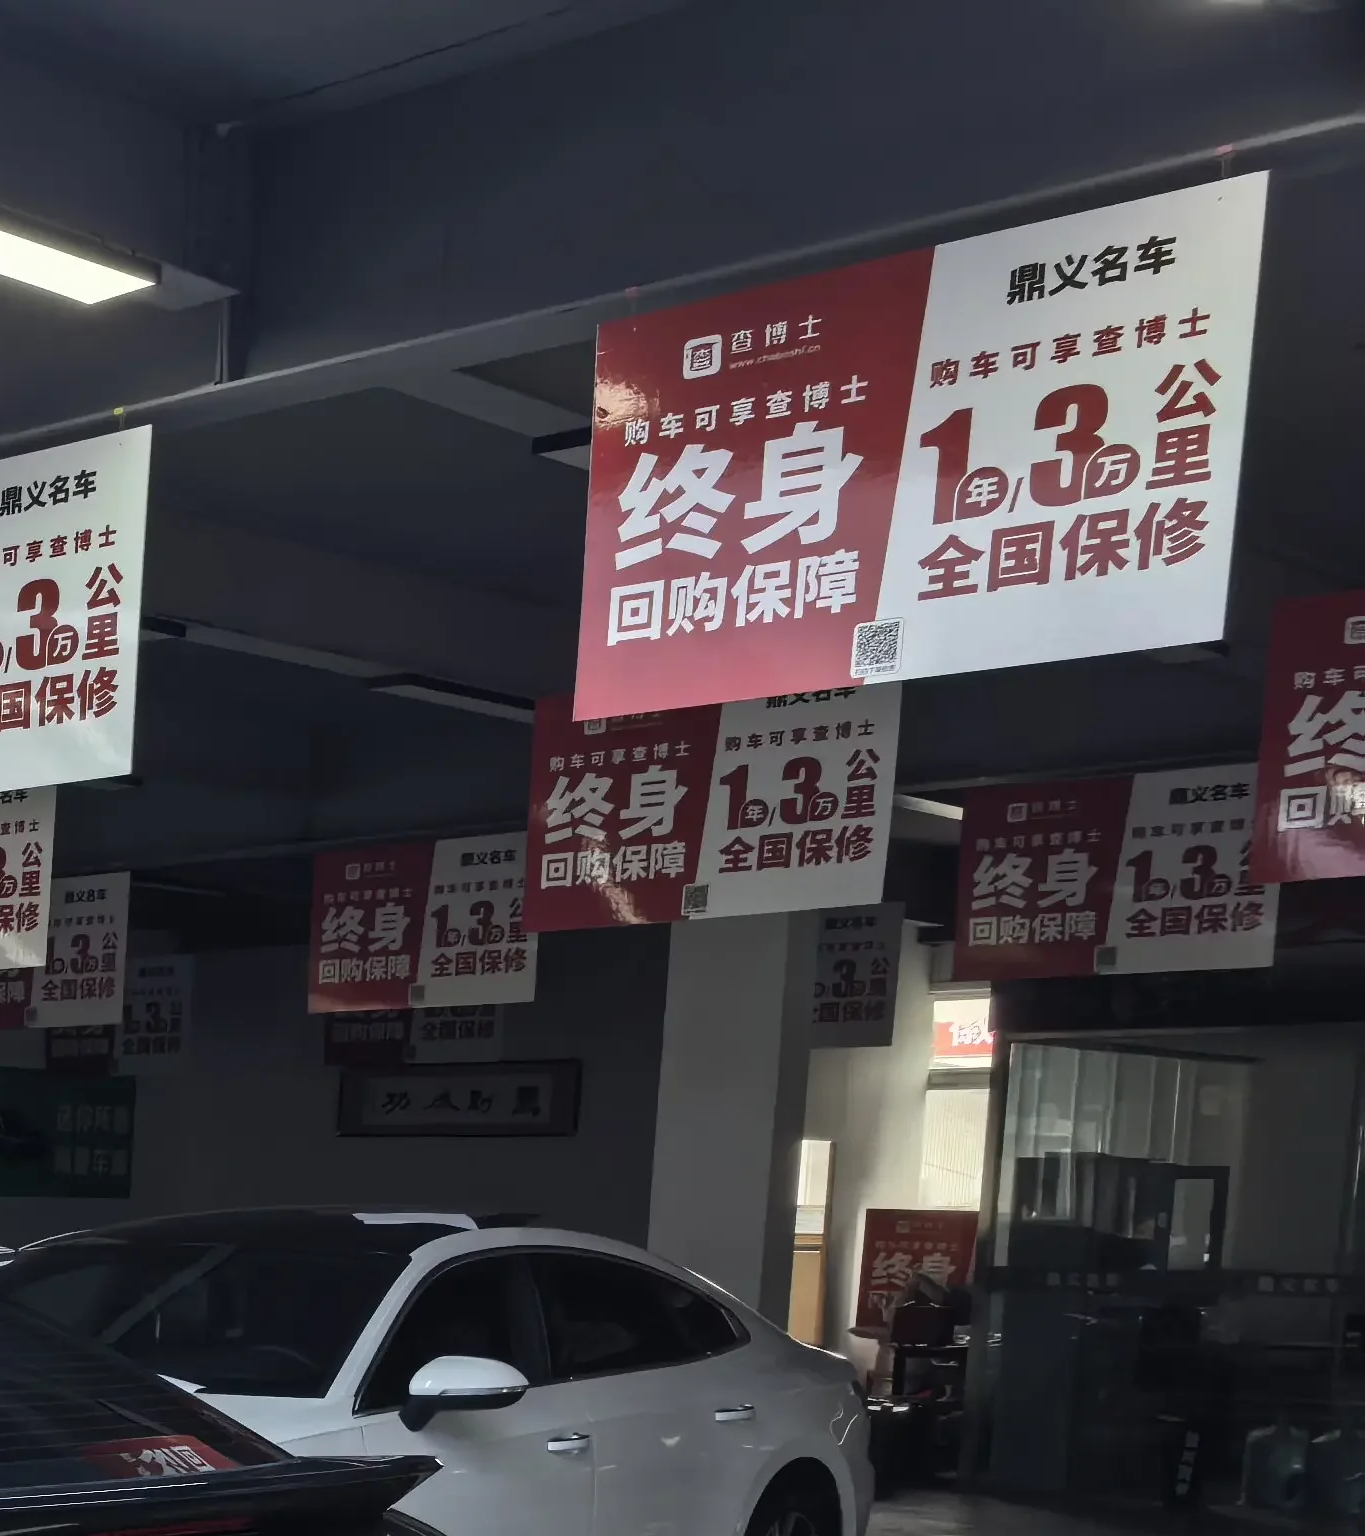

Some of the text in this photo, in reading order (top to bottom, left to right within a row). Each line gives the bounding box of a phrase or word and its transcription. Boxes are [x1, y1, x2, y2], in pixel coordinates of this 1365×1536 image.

[1006, 235, 1176, 305] 鼎义名车
[730, 315, 822, 355] 查博士
[930, 307, 1210, 388] 购车可享查博士
[624, 374, 869, 447] 购车可享查博士
[0, 469, 97, 517] 鼎义名车
[615, 420, 865, 571] 终身
[916, 498, 1210, 601] 全国保修
[606, 549, 860, 647] 回购保障
[549, 741, 691, 773] 购车可享查博士
[724, 718, 875, 752] 购车可享查博士
[544, 764, 688, 845] 终身
[541, 841, 686, 890] 回购保障
[719, 824, 874, 874] 全国保修
[971, 847, 1099, 910] 终身
[320, 902, 412, 954] 终身
[968, 910, 1098, 947] 回购保障
[1126, 902, 1264, 938] 全国保修
[319, 954, 411, 985] 回购保障
[431, 948, 527, 978] 全国保修
